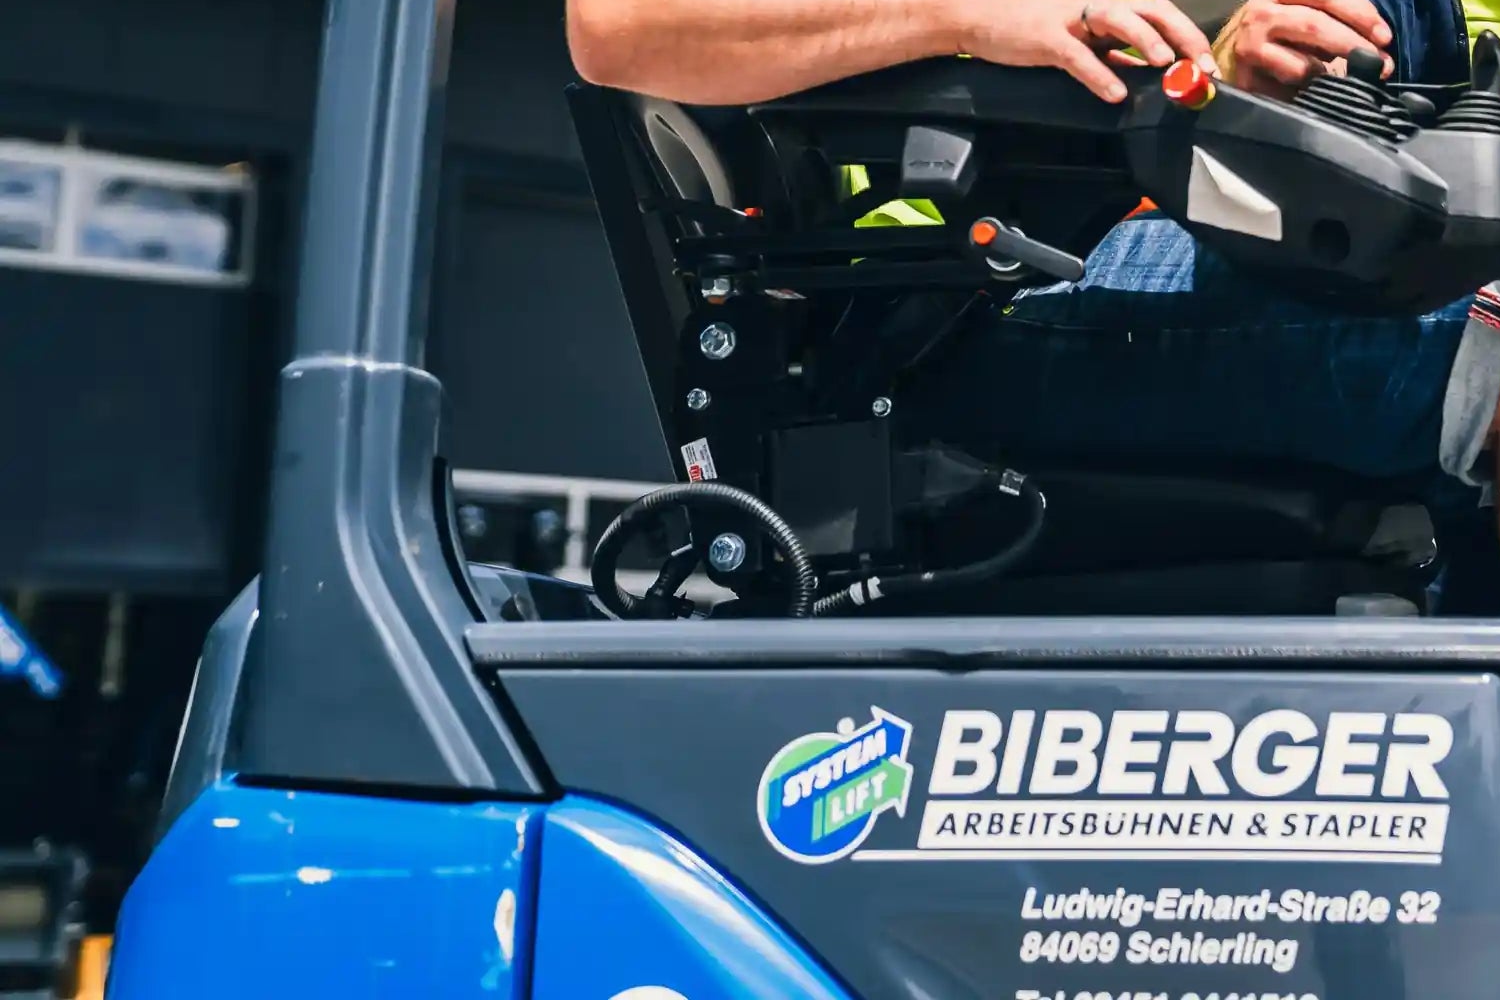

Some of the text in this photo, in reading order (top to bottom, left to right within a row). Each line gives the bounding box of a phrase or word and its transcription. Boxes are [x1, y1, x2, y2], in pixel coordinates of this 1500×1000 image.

[782, 727, 887, 808] SYSTEM
[928, 709, 1454, 799] BIBERGER
[830, 771, 888, 825] LIFT
[936, 811, 1428, 839] ARBEITSBÜHNEN & STAPLER
[1020, 887, 1442, 928] Ludwig-Erhard-Straße 32
[1019, 930, 1299, 973] 84069 Schierling
